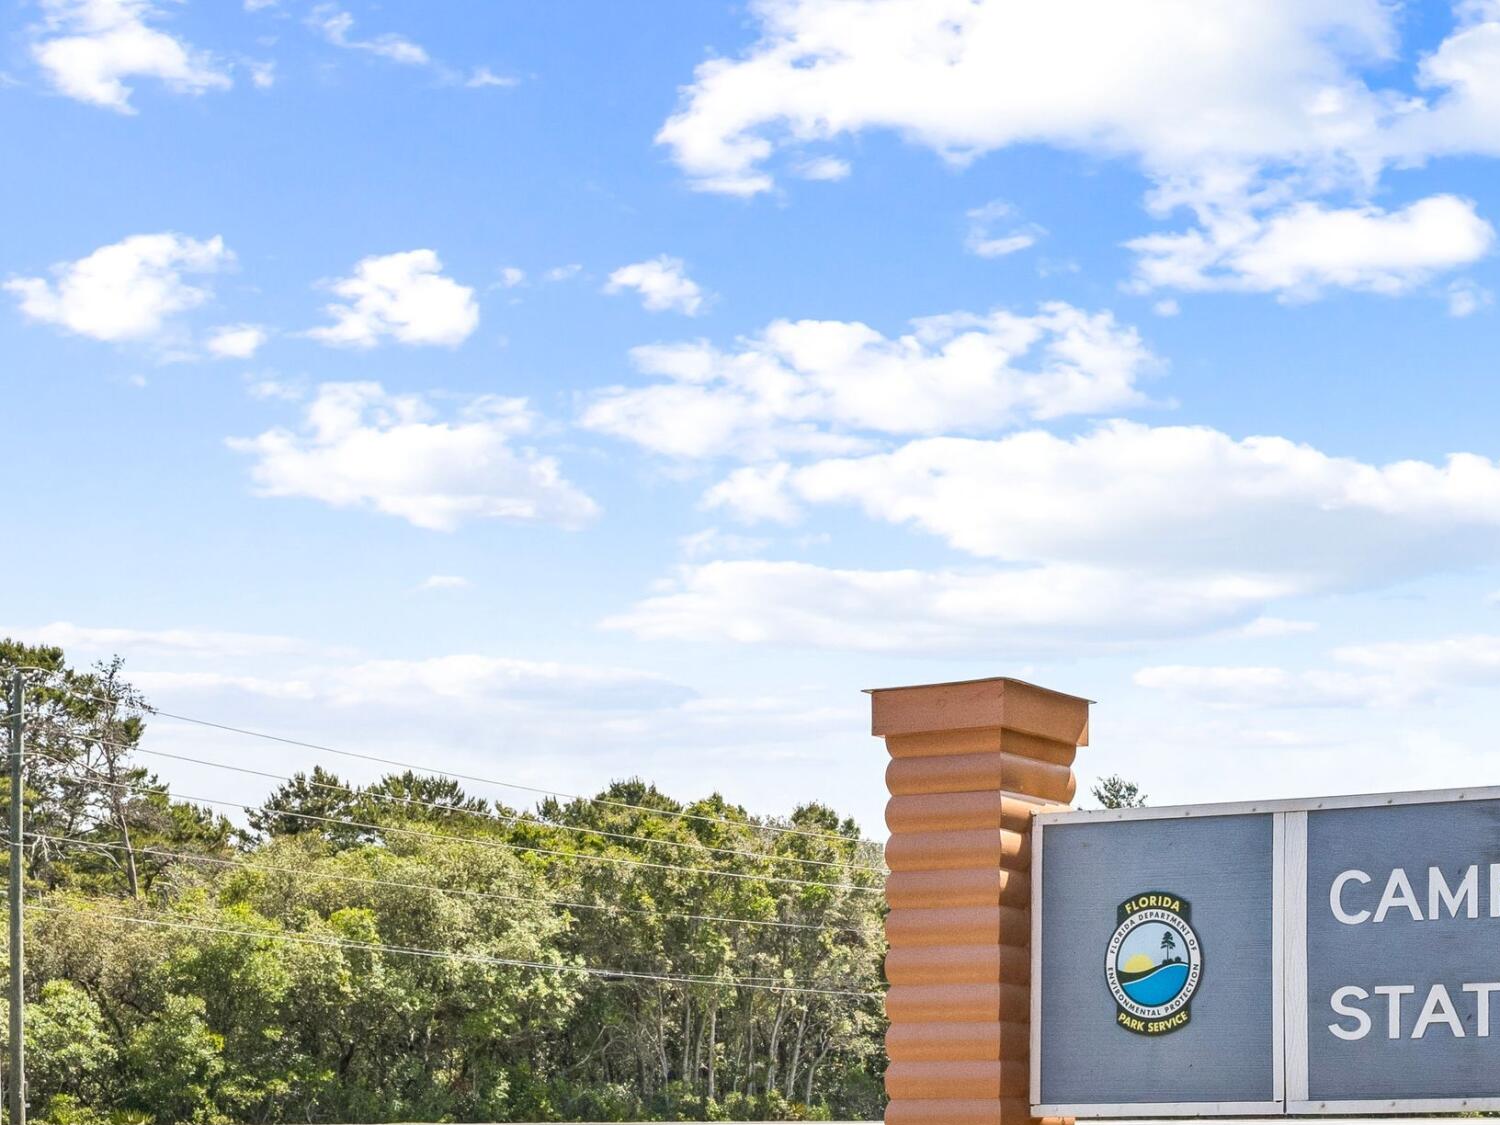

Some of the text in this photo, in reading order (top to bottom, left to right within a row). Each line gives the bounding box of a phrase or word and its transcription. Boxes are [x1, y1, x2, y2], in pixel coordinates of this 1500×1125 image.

[1125, 896, 1180, 914] FLORIDA
[1110, 912, 1197, 954] FLORIDA DEPARTMENT OF
[1108, 964, 1199, 1016] ENVIRONMENTAL PROTECTION
[1118, 1011, 1188, 1032] PARK SERVICE
